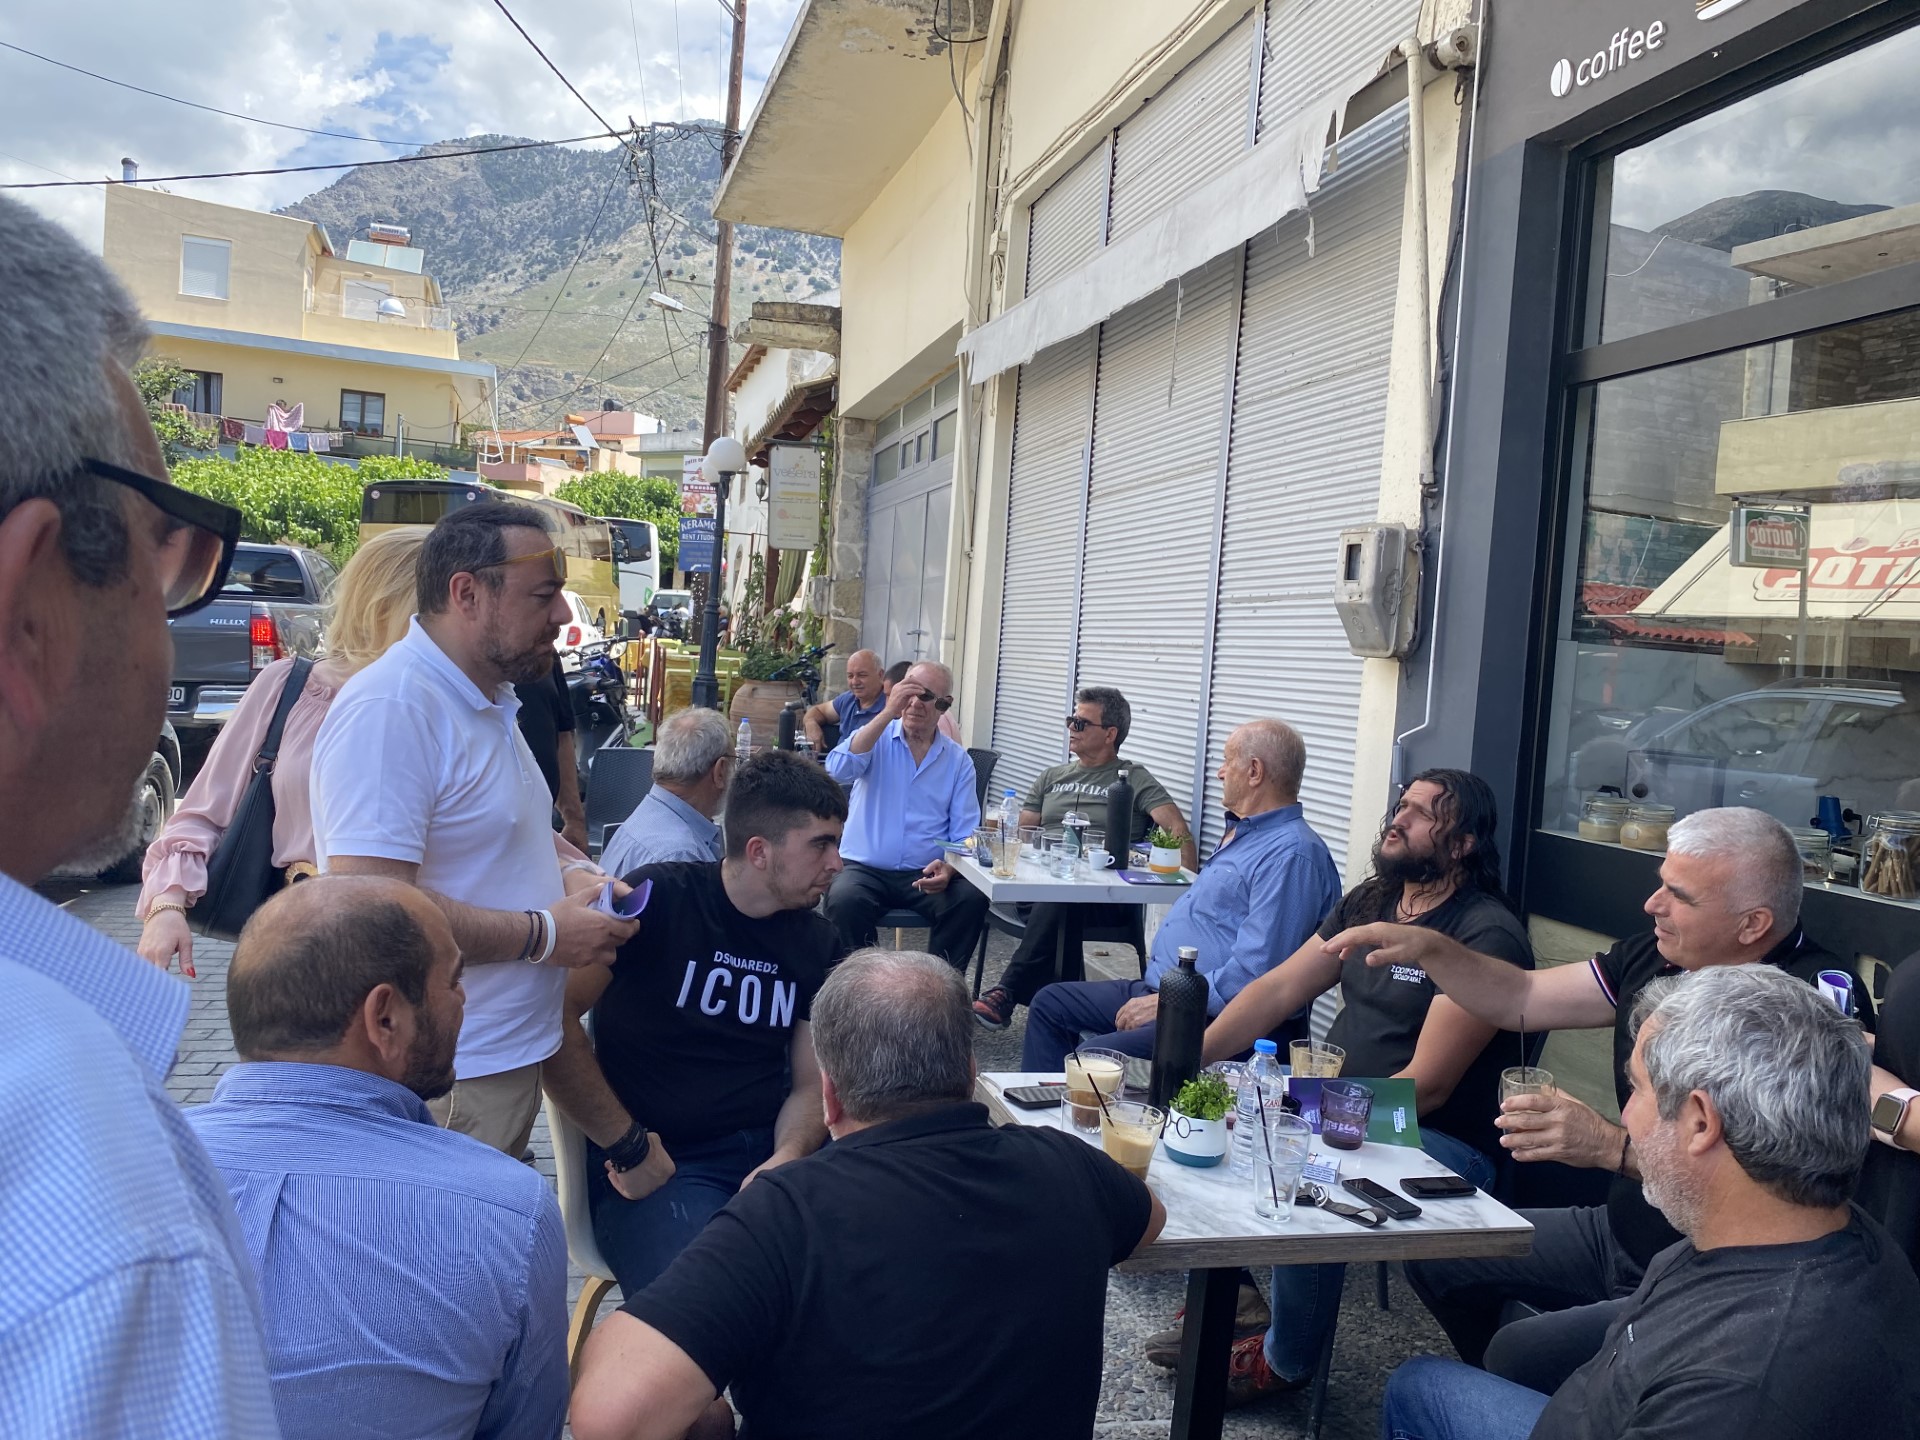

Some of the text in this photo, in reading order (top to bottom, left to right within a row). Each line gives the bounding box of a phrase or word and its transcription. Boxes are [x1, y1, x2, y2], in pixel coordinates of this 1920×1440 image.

[1576, 20, 1664, 87] coffee
[209, 618, 247, 626] HILUX
[713, 951, 779, 975] DSQUARED2
[675, 960, 797, 1028] ICON
